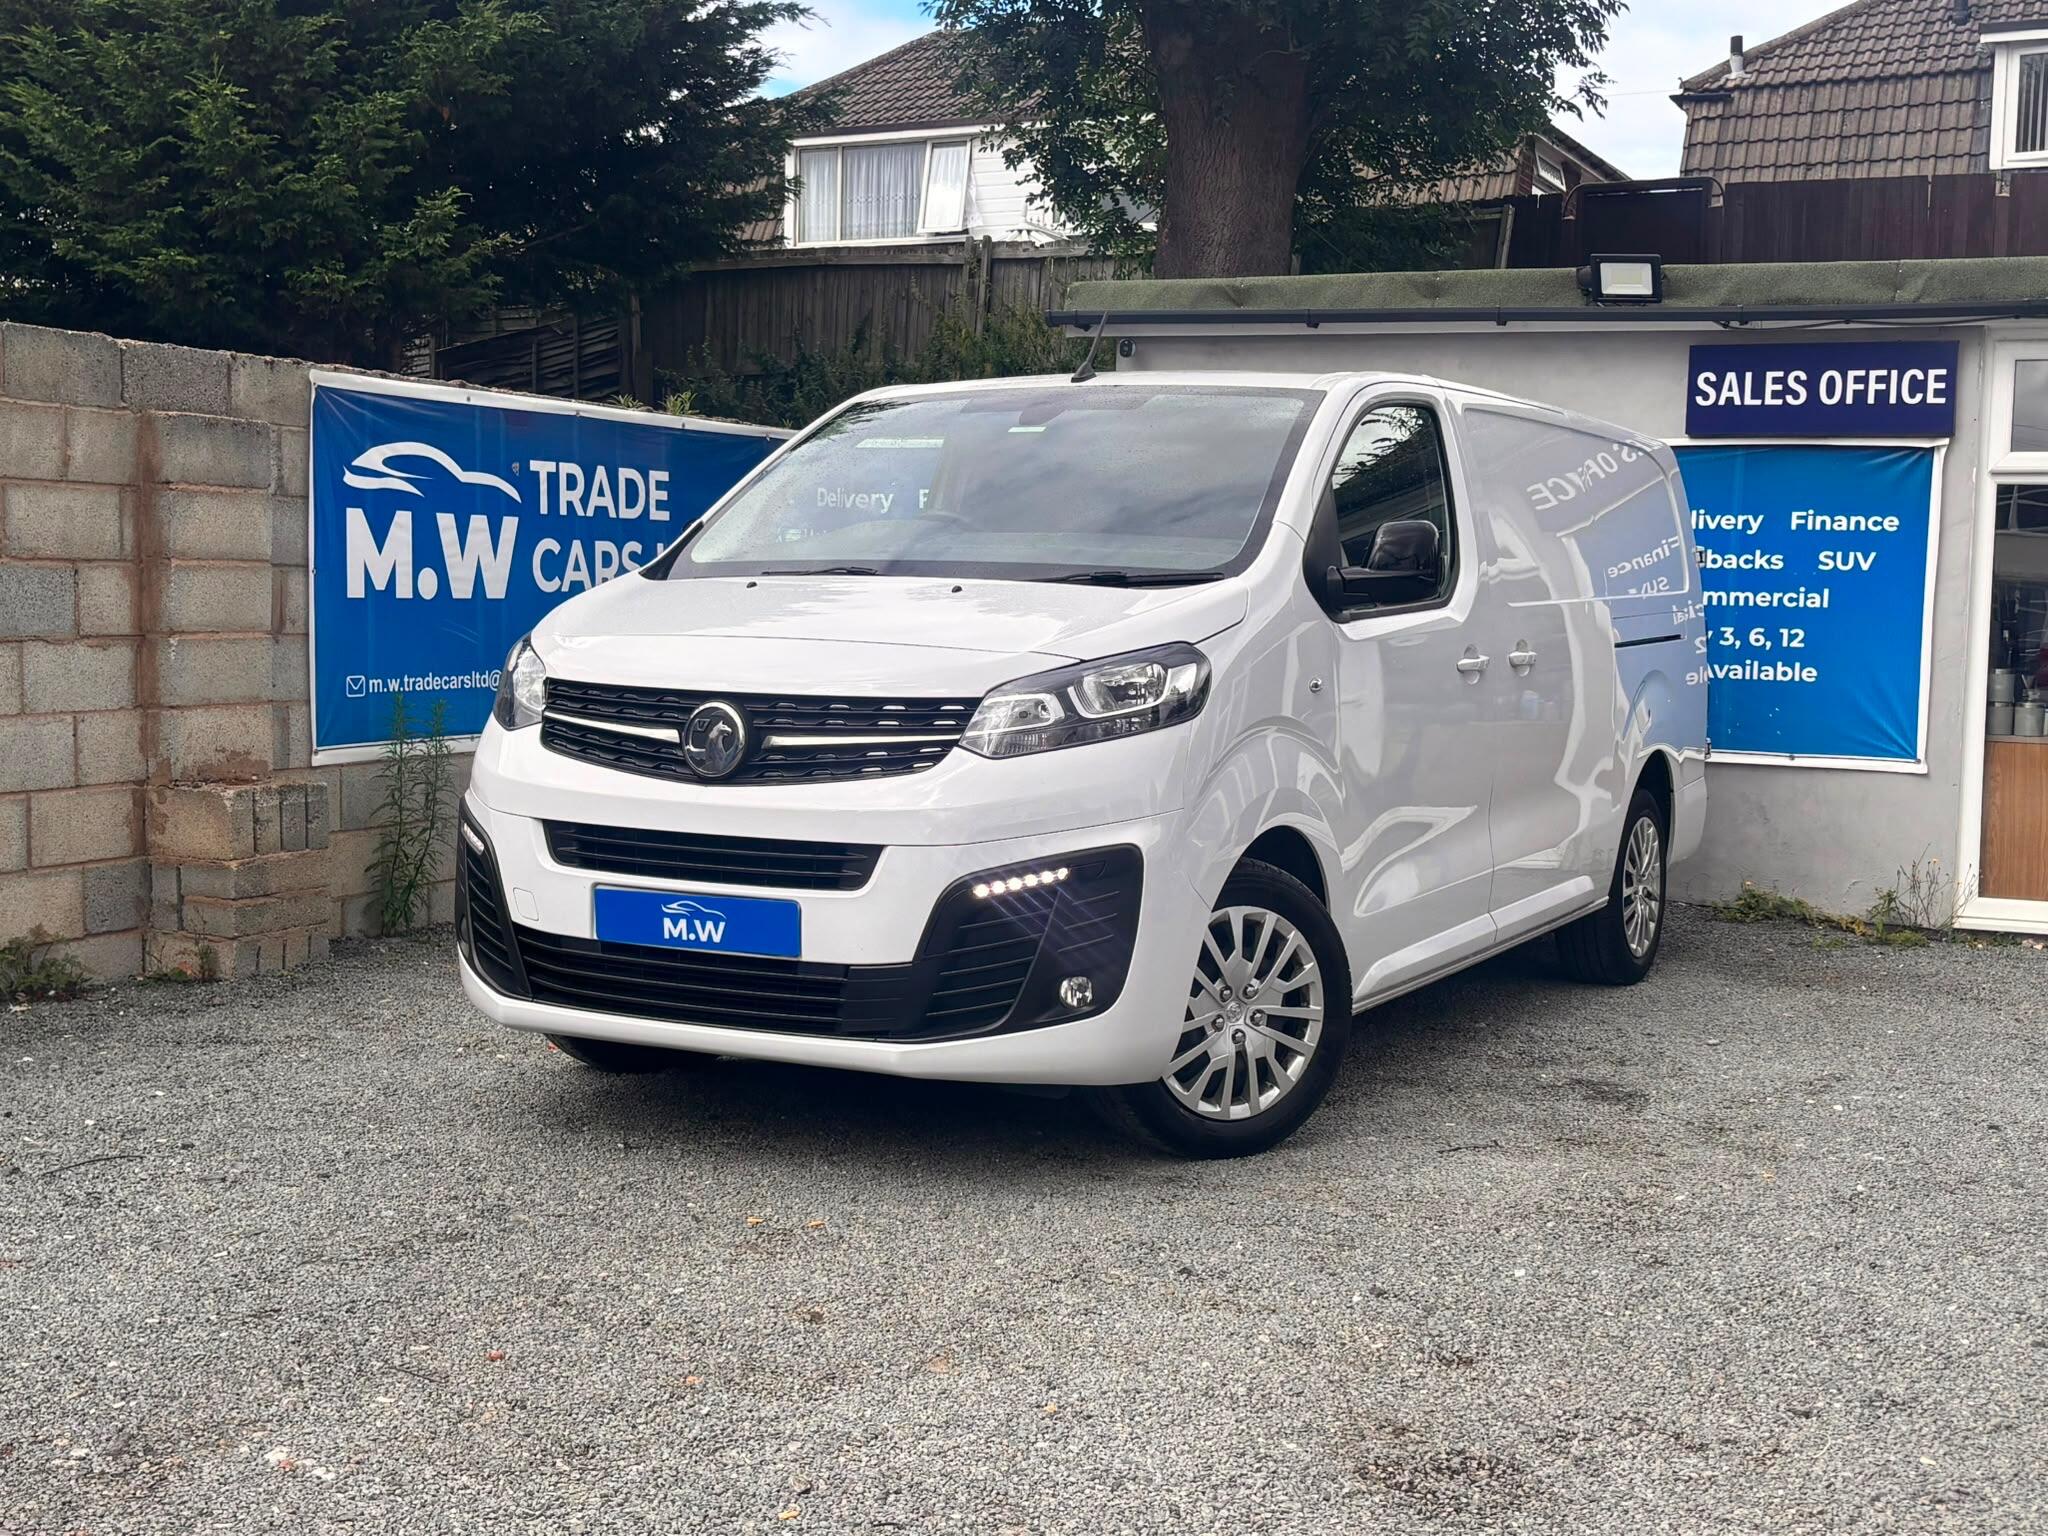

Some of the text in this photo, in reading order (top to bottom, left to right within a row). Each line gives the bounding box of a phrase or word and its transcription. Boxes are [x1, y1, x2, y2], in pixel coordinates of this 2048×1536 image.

[1695, 369, 1947, 406] SALES OFFICE
[530, 459, 670, 521] TRADE
[816, 487, 894, 513] Delivery
[1791, 509, 1899, 532] Finance
[346, 507, 518, 600] M.W
[532, 537, 643, 593] CARS
[1818, 551, 1876, 571] SUV
[1719, 627, 1741, 650] 3,
[1748, 627, 1772, 650] 6,
[1779, 628, 1805, 647] 12
[663, 916, 726, 944] M.W
